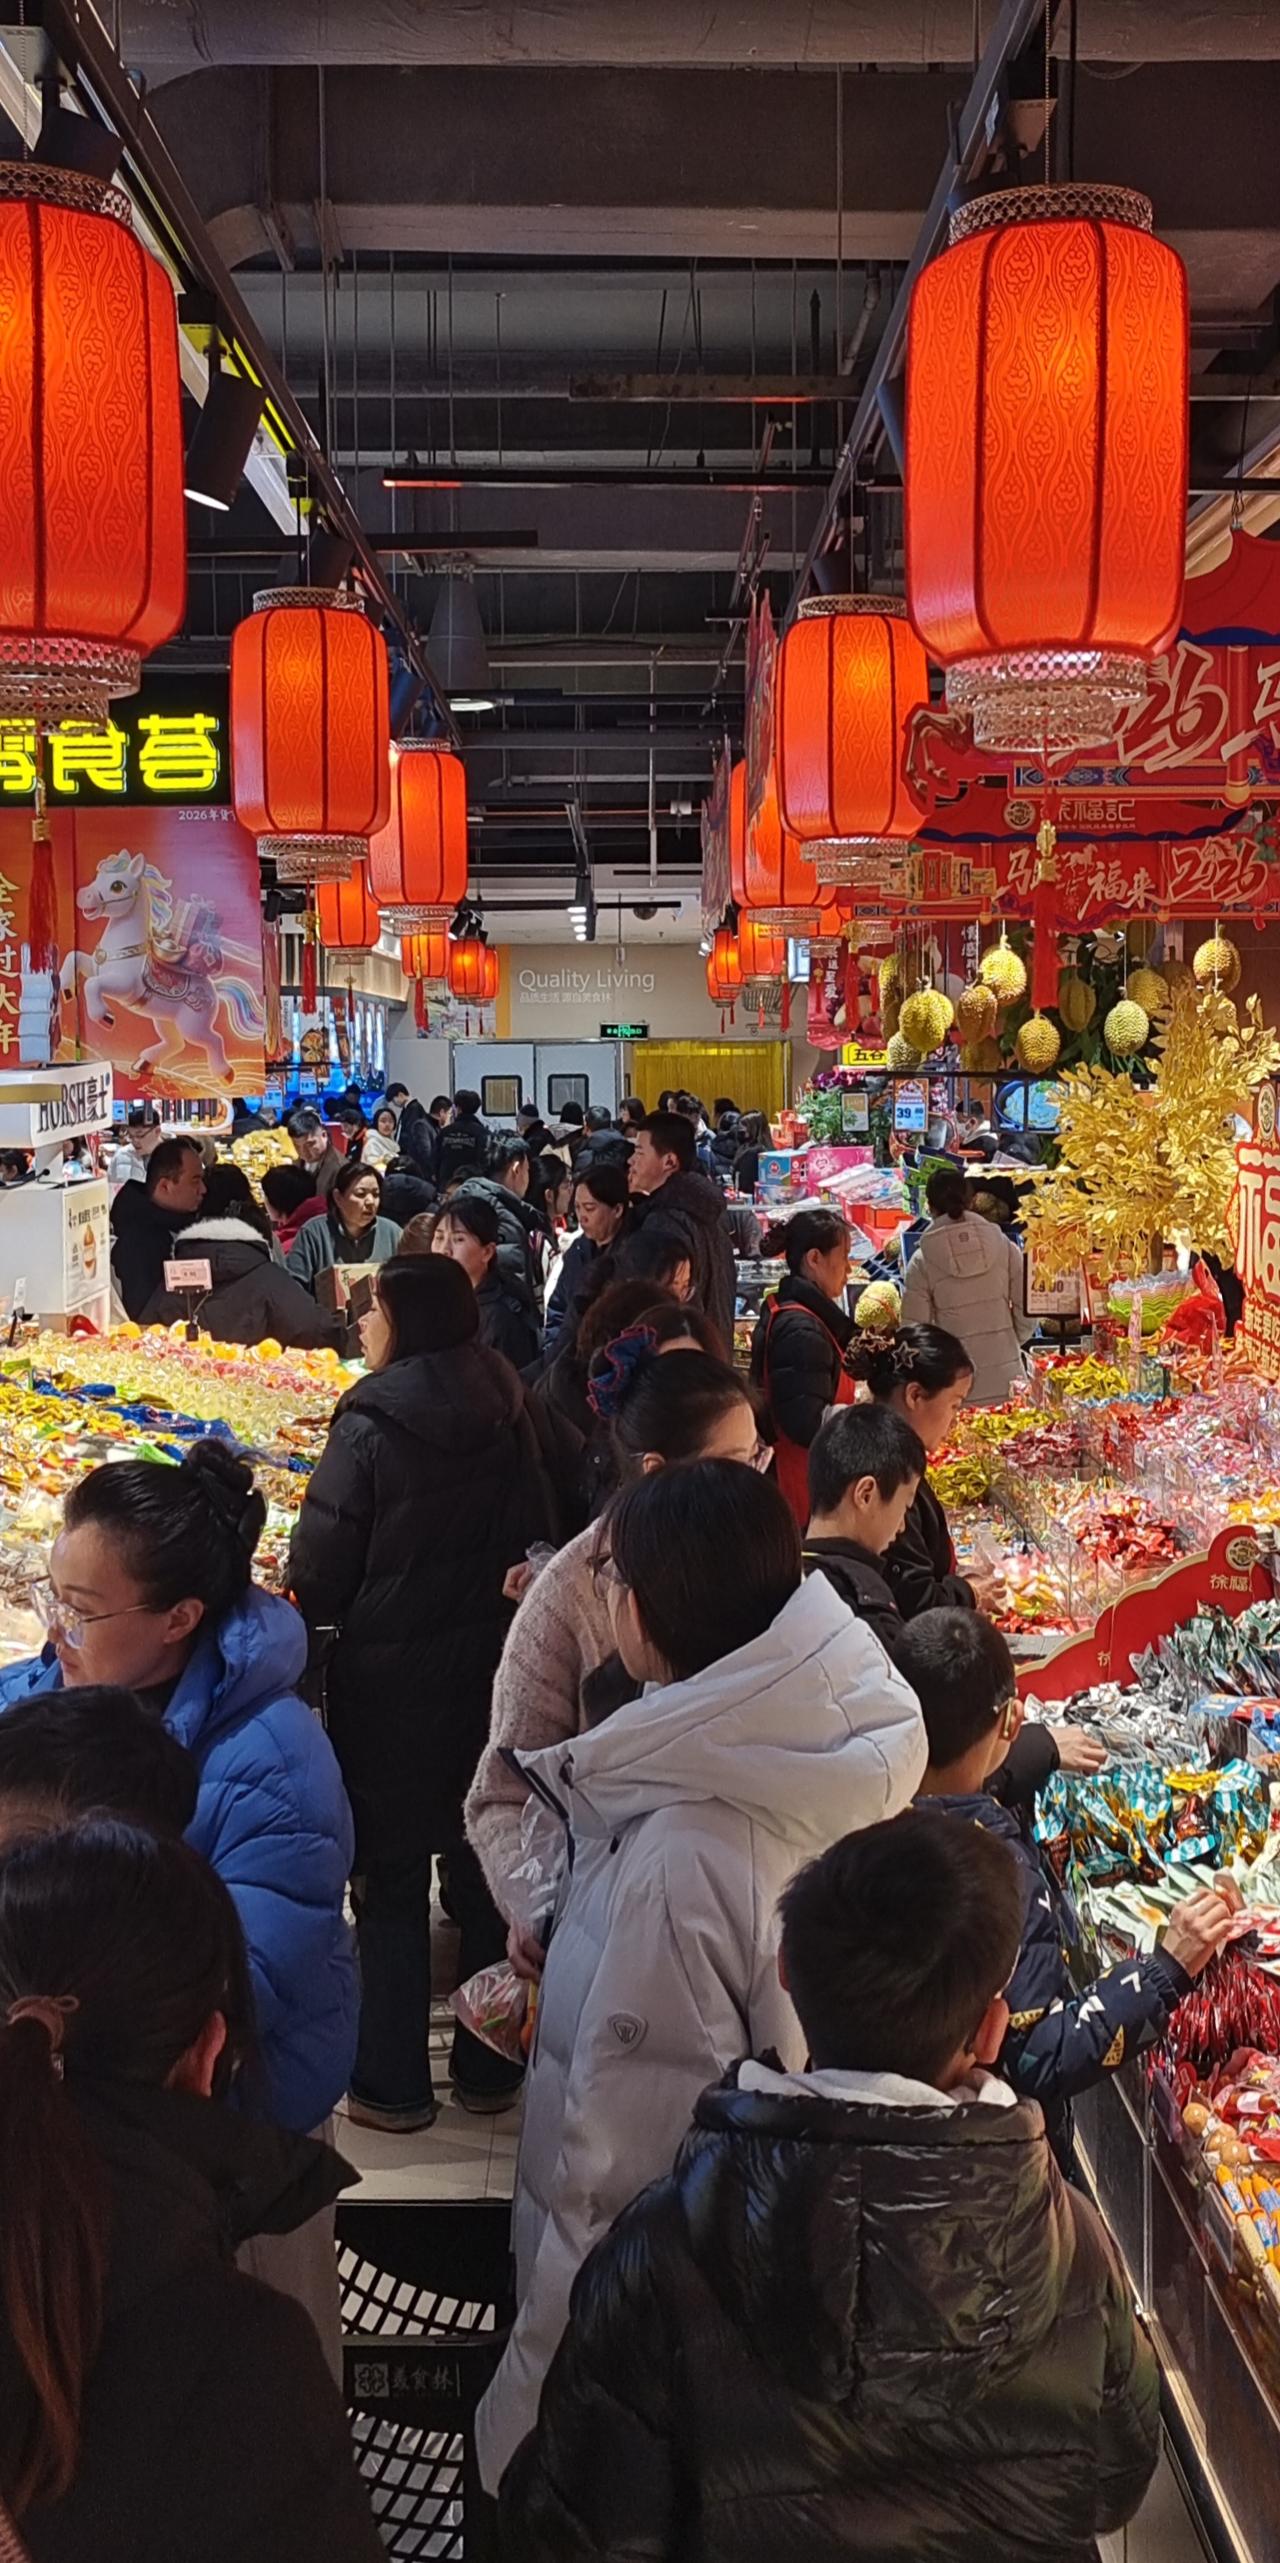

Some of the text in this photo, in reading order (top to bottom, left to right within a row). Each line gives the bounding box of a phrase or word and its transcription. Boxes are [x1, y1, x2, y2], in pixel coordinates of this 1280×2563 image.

[519, 969, 655, 992] Quality Living
[896, 1107, 911, 1118] 39
